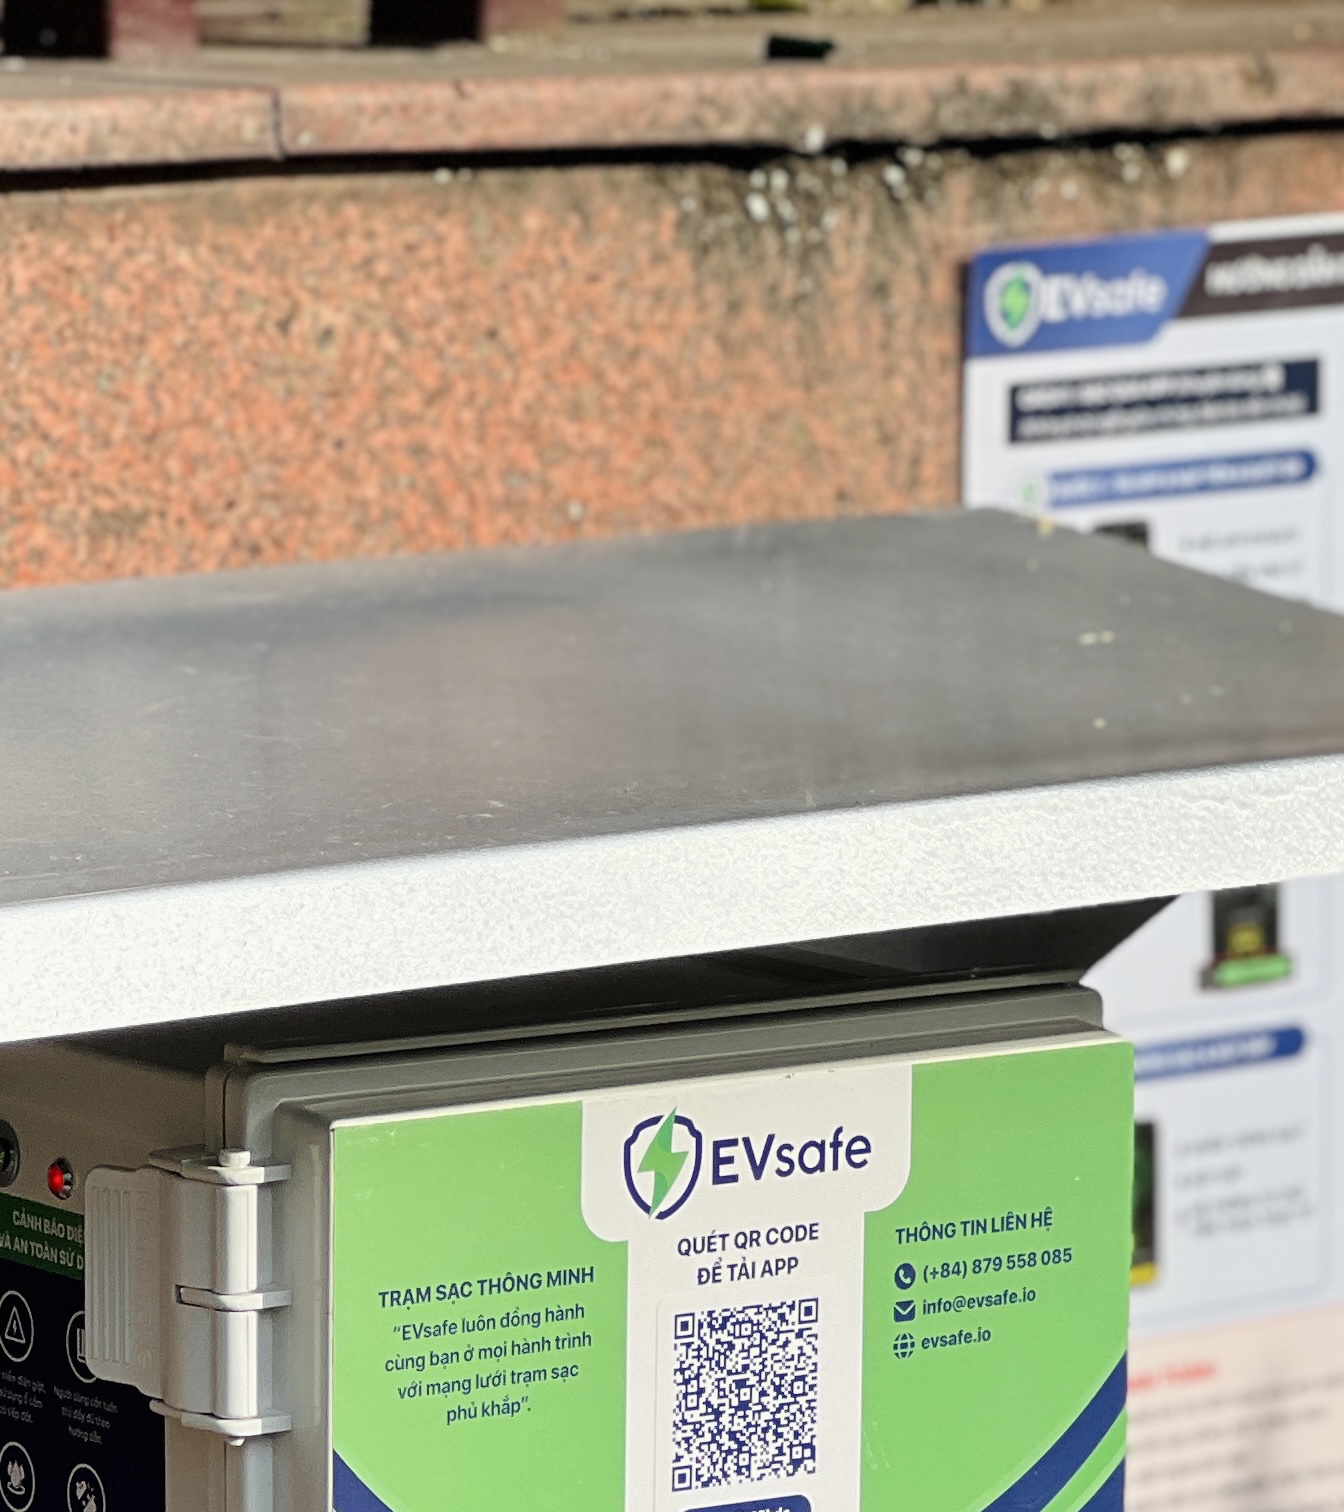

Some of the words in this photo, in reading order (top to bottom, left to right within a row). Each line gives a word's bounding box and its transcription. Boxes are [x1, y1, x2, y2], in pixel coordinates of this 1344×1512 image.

[712, 1125, 872, 1186] EVsafe
[12, 1206, 42, 1232] CẢNH
[44, 1217, 66, 1241] BÁO
[677, 1229, 730, 1256] QUÉT
[734, 1230, 761, 1250] QR
[765, 1222, 820, 1246] CODE
[895, 1220, 957, 1245] THÔNG
[960, 1218, 987, 1237] TIN
[991, 1211, 1027, 1233] LIÊN
[1031, 1206, 1053, 1232] HỆ
[13, 1236, 28, 1255] AN
[30, 1241, 58, 1264] TOÀN
[60, 1247, 75, 1267] SỬ
[923, 1260, 968, 1283] (+84)
[971, 1256, 1003, 1275] 879
[1006, 1251, 1037, 1270] 558
[1041, 1247, 1073, 1266] 085
[379, 1286, 431, 1310] TRẠM
[436, 1281, 473, 1304] SẠC
[477, 1272, 542, 1296] THÔNG
[547, 1266, 594, 1288] MINH
[697, 1256, 722, 1286] ĐỂ
[726, 1256, 756, 1282] TẢI
[760, 1256, 799, 1278] APP
[461, 1314, 496, 1333] luôn
[500, 1306, 541, 1329] đồng
[545, 1303, 585, 1323] hành
[922, 1286, 1037, 1316] info@evsafe.io
[385, 1354, 426, 1372] cùng
[430, 1350, 459, 1370] bạn
[464, 1344, 474, 1362] ở
[479, 1341, 507, 1363] mọi
[511, 1336, 551, 1356] hành
[555, 1331, 592, 1351] trình
[921, 1326, 991, 1350] evsafe.io
[398, 1380, 423, 1400] với
[426, 1378, 472, 1398] mạng
[476, 1369, 507, 1390] lưới
[511, 1369, 547, 1387] trạm
[551, 1363, 579, 1383] sạc
[446, 1401, 477, 1426] phủ
